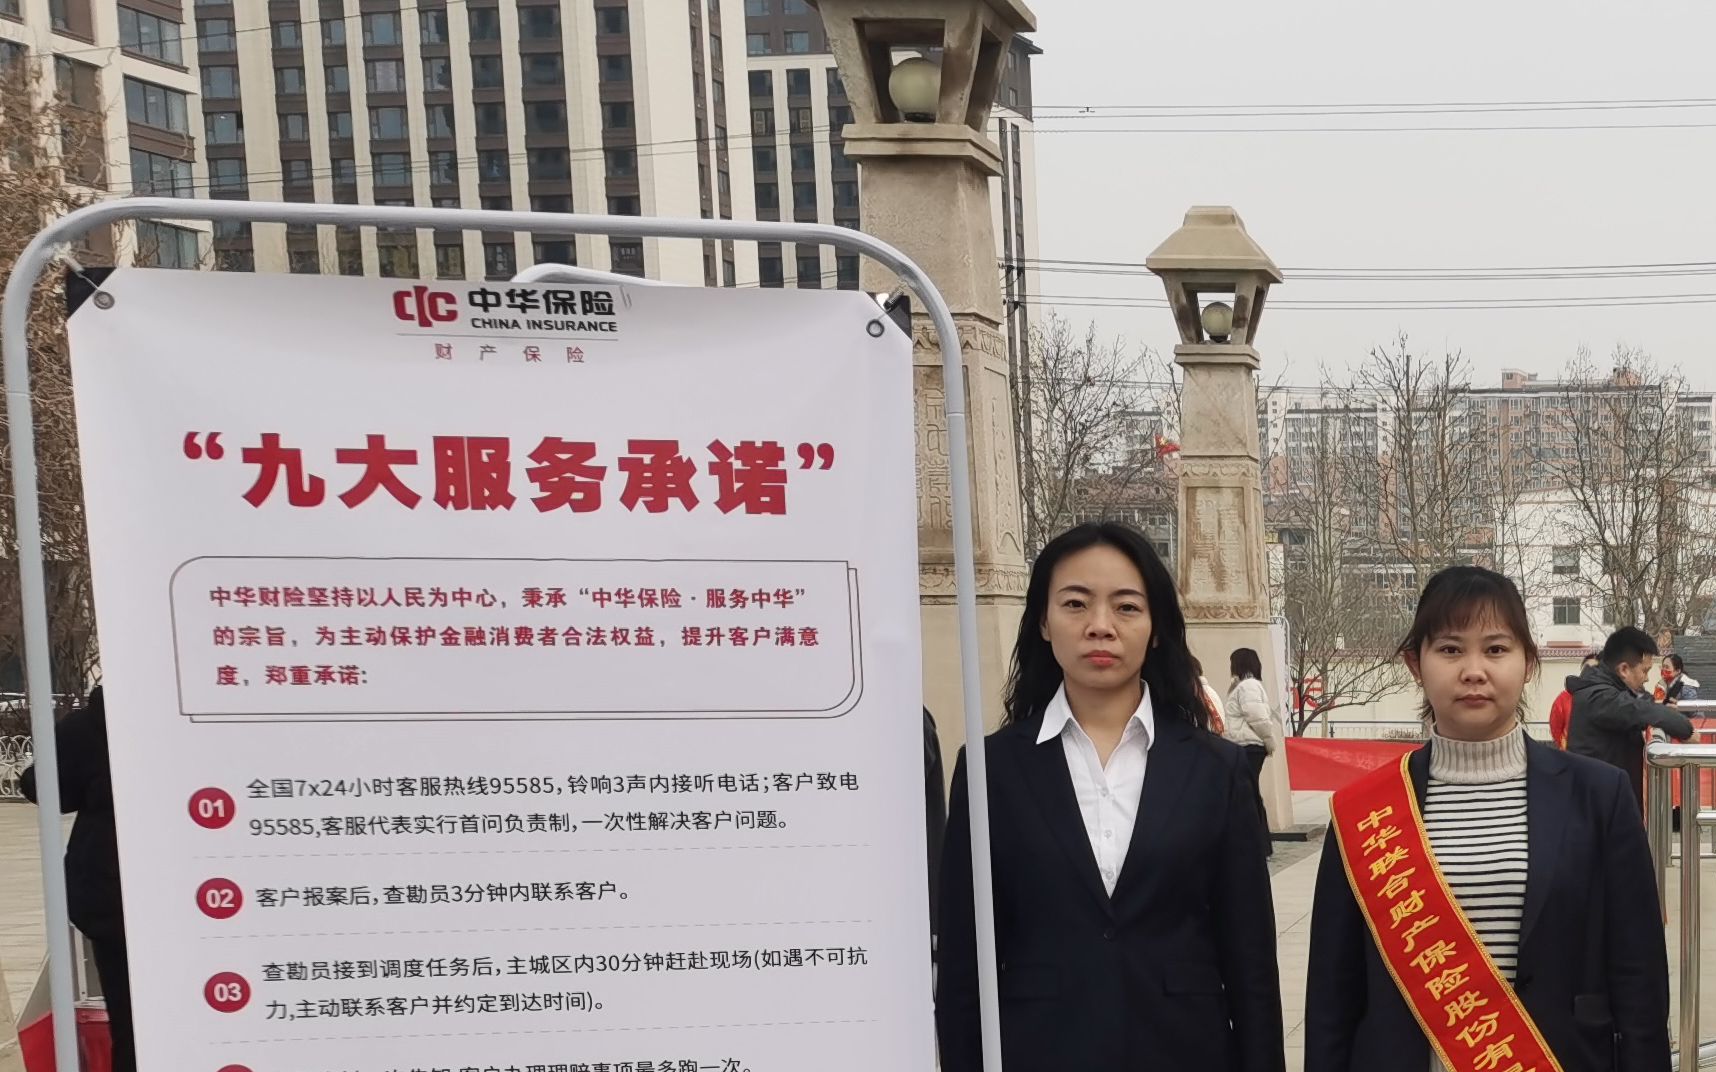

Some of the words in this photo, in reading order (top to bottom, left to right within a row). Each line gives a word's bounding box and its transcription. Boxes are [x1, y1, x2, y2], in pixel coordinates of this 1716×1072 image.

[467, 287, 615, 317] 中华保险
[470, 317, 521, 329] CHINA
[526, 319, 617, 331] INSURANCE
[434, 342, 584, 363] 财产保险
[182, 431, 834, 515] “九大服务承诺”
[212, 625, 818, 647] 的宗旨，为主动保护金融消费者合法权益，提升客户满意
[197, 798, 226, 819] 01
[206, 888, 235, 909] 02
[214, 982, 242, 1003] 03
